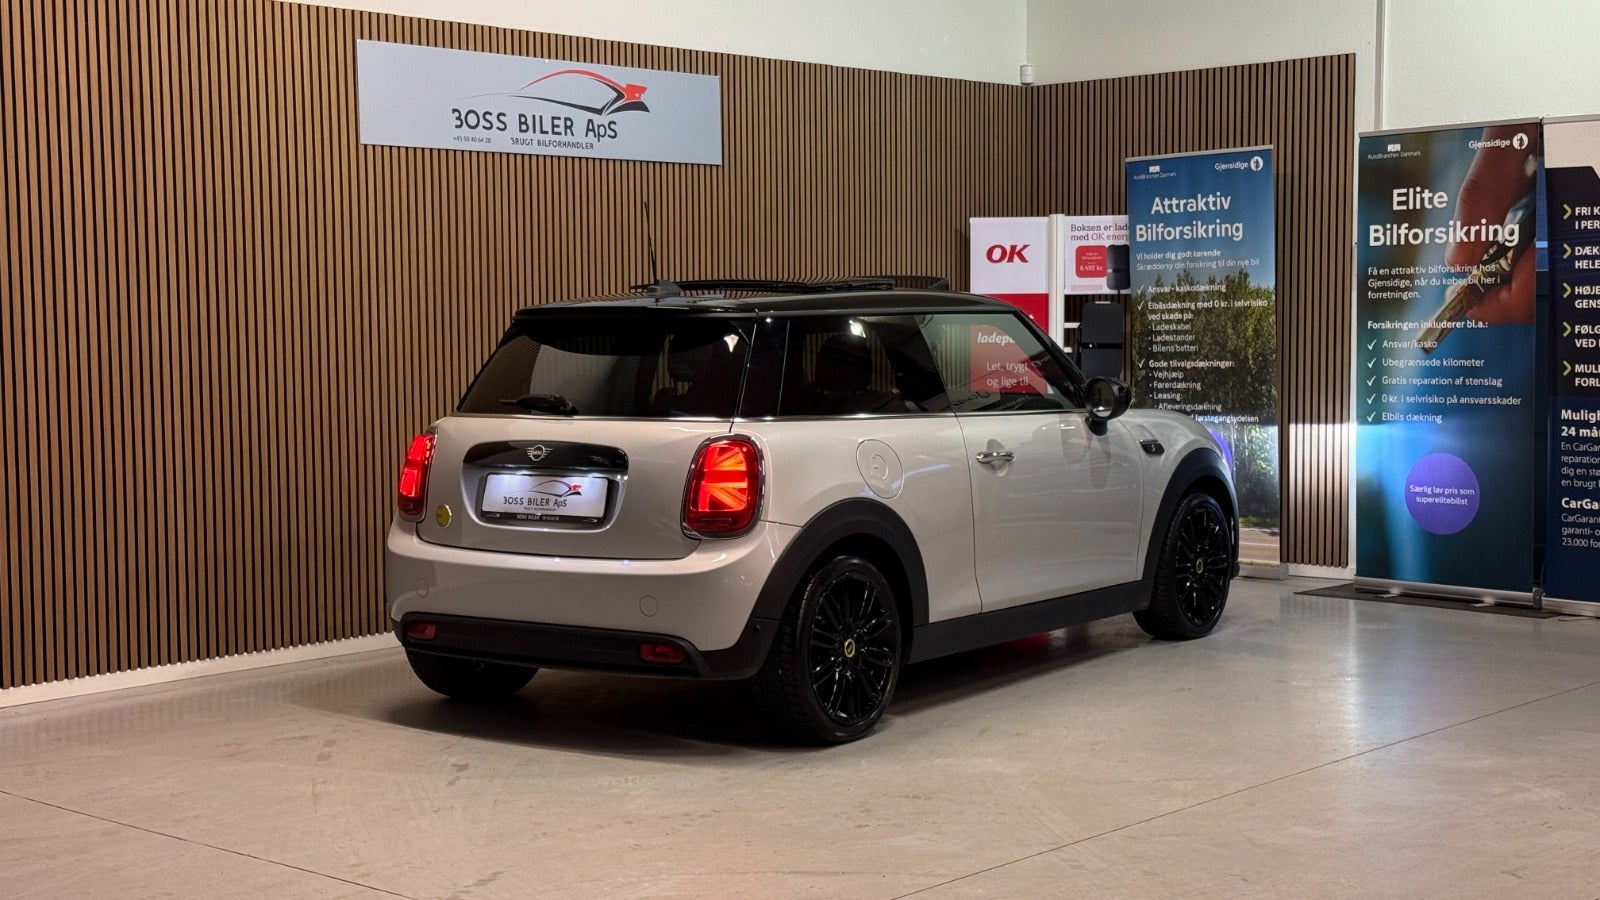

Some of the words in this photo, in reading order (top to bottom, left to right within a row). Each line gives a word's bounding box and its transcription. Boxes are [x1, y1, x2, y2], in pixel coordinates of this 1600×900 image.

[452, 108, 507, 132] BOSS
[518, 114, 574, 136] BILER
[585, 119, 618, 142] ApS
[510, 137, 534, 146] BRUGT
[537, 139, 594, 150] BILFORHANDLER
[1468, 139, 1511, 150] Gjensidige
[1214, 162, 1249, 172] Gjensidige
[1151, 192, 1231, 214] Attraktiv
[1392, 186, 1448, 210] Elite
[1575, 206, 1590, 216] FRI
[1071, 224, 1102, 232] Boksen
[1114, 223, 1128, 232] lad
[1136, 219, 1243, 241] Bilforsikring
[1576, 220, 1578, 230] I
[1581, 220, 1600, 230] PER
[1071, 232, 1089, 240] med
[1370, 218, 1520, 247] Bilforsikring
[986, 244, 1030, 264] OK
[1165, 251, 1176, 260] dig
[1178, 250, 1192, 260] godt
[1575, 246, 1600, 256] DÆK
[1136, 263, 1173, 272] Skræddersy
[1174, 261, 1185, 269] din
[1186, 260, 1216, 269] forsikring
[1226, 259, 1236, 267] din
[1238, 260, 1249, 268] nye
[1368, 266, 1378, 276] Få
[1391, 266, 1426, 274] attraktiv
[1428, 264, 1478, 274] bilforsikring
[1480, 264, 1496, 272] hos
[1575, 260, 1600, 270] HELE
[1368, 278, 1412, 289] Gjensidige,
[1415, 276, 1428, 286] når
[1430, 276, 1440, 285] du
[1468, 276, 1478, 285] bil
[1480, 276, 1495, 284] her
[1176, 283, 1226, 293] kaskodækning
[1574, 286, 1600, 295] HØJE
[1368, 290, 1421, 300] forretningen.
[1148, 302, 1196, 310] Elbilsdækning
[1196, 300, 1212, 308] med
[1214, 300, 1220, 308] 0
[1234, 299, 1268, 308] selvrisiko
[1148, 312, 1160, 320] ved
[1162, 312, 1182, 320] skade
[1368, 320, 1419, 330] Forsikringen
[1421, 320, 1464, 329] inkluderer
[1152, 344, 1174, 352] Bilens
[1176, 344, 1198, 352] batteri
[1382, 340, 1438, 348] Ansvar/kasko
[1575, 338, 1596, 348] VED
[1006, 362, 1029, 373] trygt
[1382, 358, 1441, 368] Ubegrænsede
[1442, 358, 1484, 366] kilometer
[1154, 370, 1184, 380] Vejhjælp
[987, 380, 998, 388] og
[1002, 376, 1018, 388] lige
[1020, 376, 1028, 386] til
[1154, 381, 1201, 390] Førerdækning
[1382, 376, 1406, 385] Gratis
[1409, 376, 1452, 386] reparation
[1454, 376, 1463, 385] af
[1465, 376, 1502, 387] stenslag
[1382, 394, 1388, 402] 0
[1389, 394, 1400, 402] kr.
[1406, 394, 1444, 404] selvrisiko
[1447, 394, 1458, 406] på
[1460, 396, 1522, 406] ansvarsskader
[1158, 403, 1222, 412] Afleveringsdækning
[1382, 412, 1404, 421] Elbils
[1406, 413, 1442, 424] dækning
[1561, 426, 1576, 437] 24
[1561, 442, 1571, 450] En
[1561, 466, 1574, 476] dig
[1561, 479, 1572, 487] en
[1574, 478, 1596, 490] brugt
[1410, 484, 1432, 494] Særlig
[1433, 486, 1443, 494] lav
[1445, 486, 1458, 495] pris
[504, 496, 524, 506] BOSS
[528, 498, 550, 507] BILER
[553, 498, 568, 508] ApS
[1562, 537, 1588, 546] 23.000
